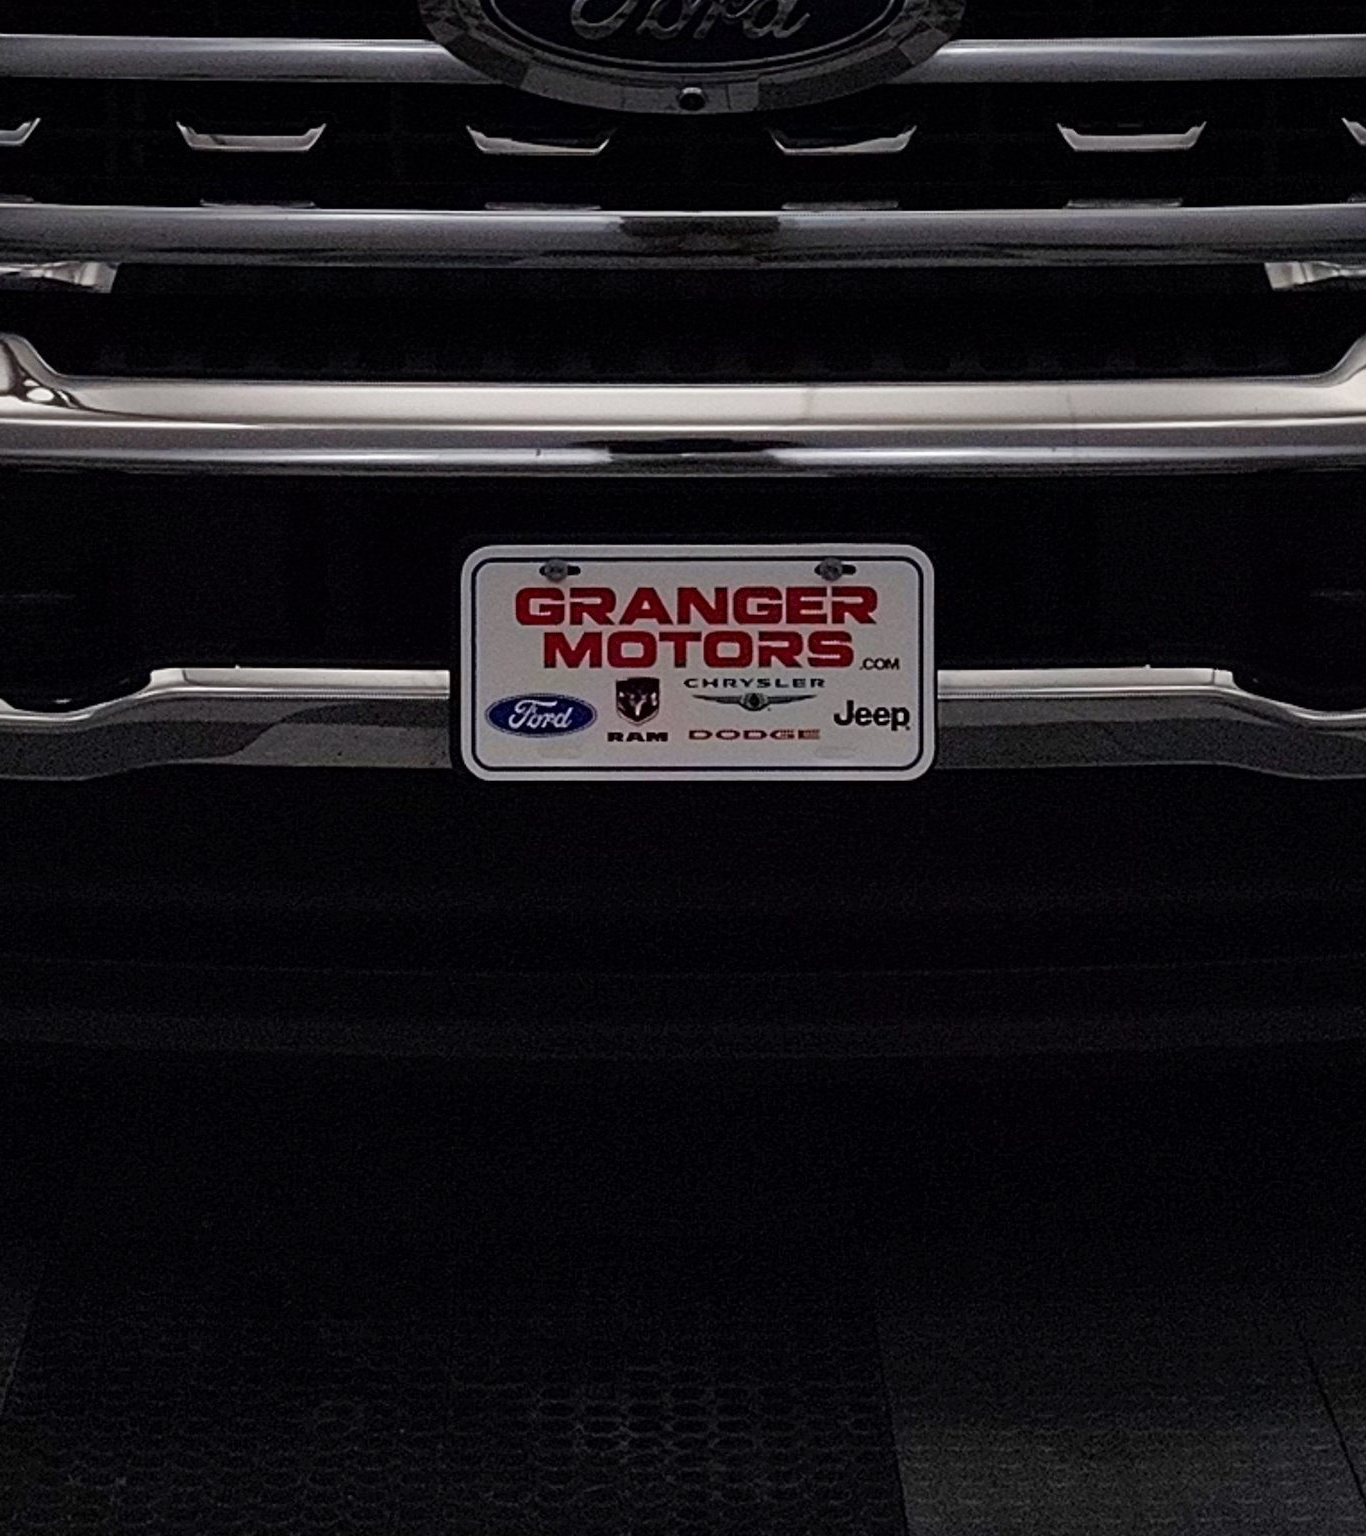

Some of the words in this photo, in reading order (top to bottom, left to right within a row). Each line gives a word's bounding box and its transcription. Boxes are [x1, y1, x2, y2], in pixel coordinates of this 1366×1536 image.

[514, 585, 878, 626] GRANGER
[542, 629, 855, 670] MOTORS
[683, 677, 827, 689] CHRYSLER
[507, 699, 574, 730] Ford
[833, 699, 911, 732] Jeep
[606, 731, 669, 743] RAM
[688, 728, 821, 741] DODGE
